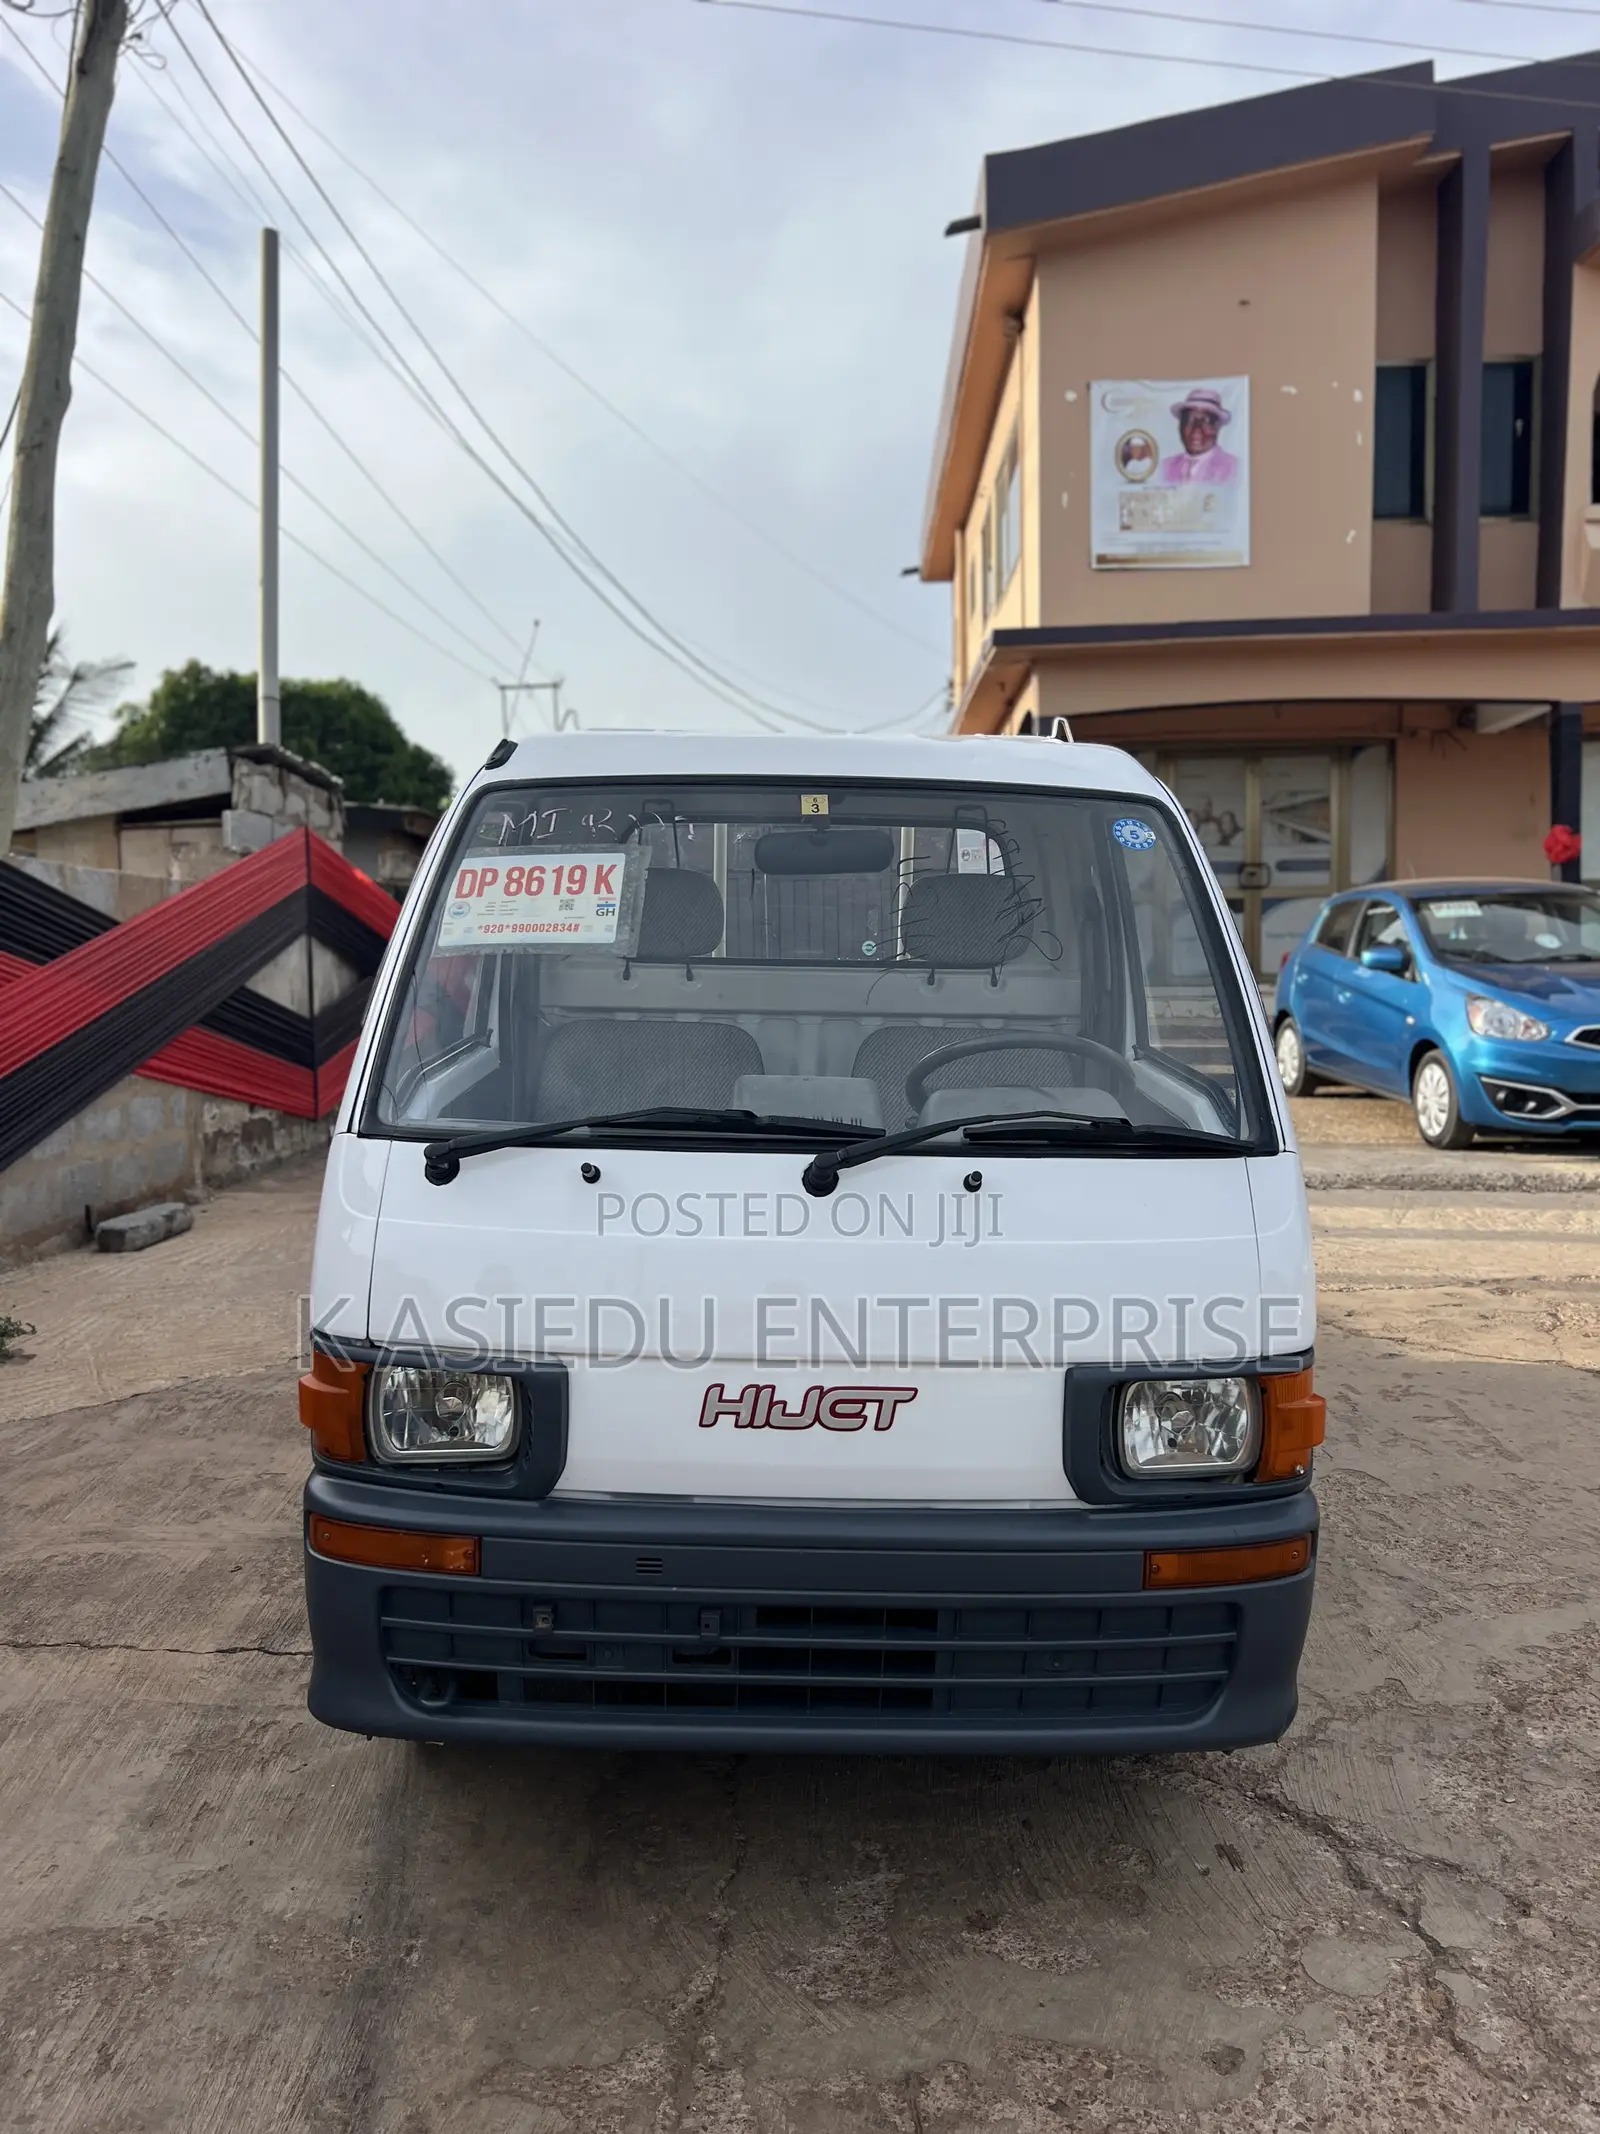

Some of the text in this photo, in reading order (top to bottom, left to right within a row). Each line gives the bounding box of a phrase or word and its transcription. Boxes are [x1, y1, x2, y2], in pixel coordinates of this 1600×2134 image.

[811, 804, 820, 813] 3
[1130, 830, 1140, 840] 5
[455, 864, 618, 899] DP 8619 K
[595, 907, 616, 917] GH
[698, 1382, 919, 1432] HIJET
